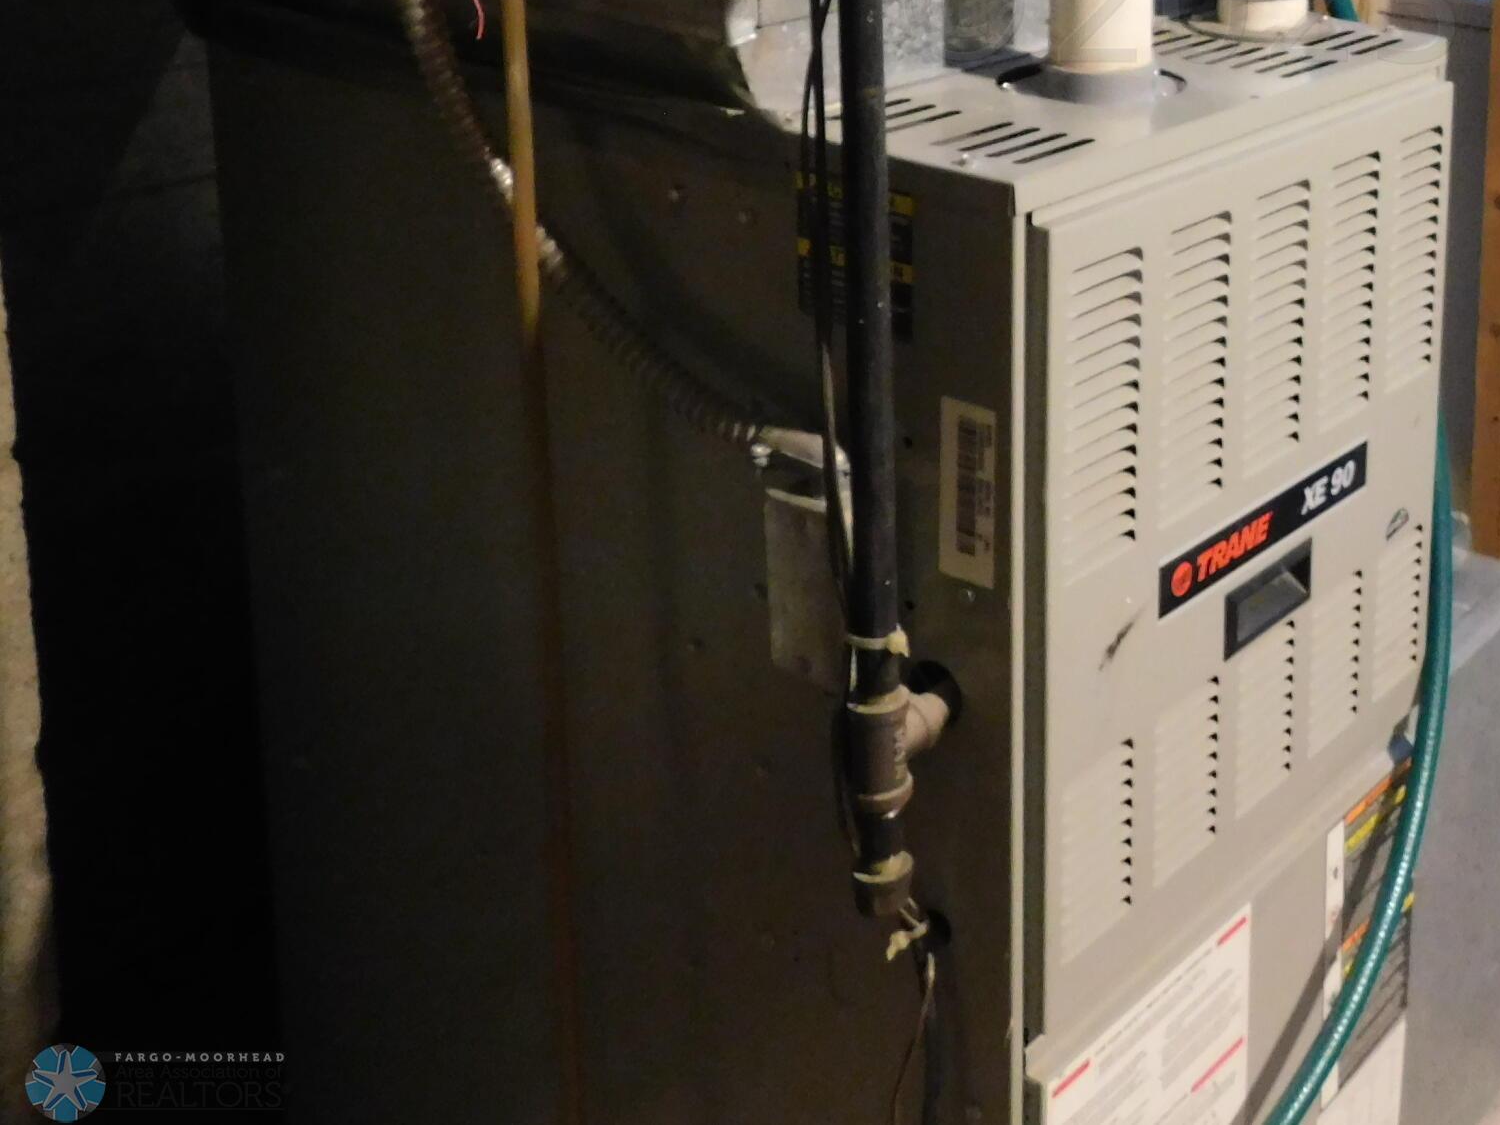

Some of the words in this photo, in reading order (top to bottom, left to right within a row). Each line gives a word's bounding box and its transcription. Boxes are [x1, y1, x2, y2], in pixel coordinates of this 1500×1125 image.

[1197, 511, 1274, 582] TRANE
[1301, 476, 1328, 515] XE
[1330, 459, 1356, 496] 90
